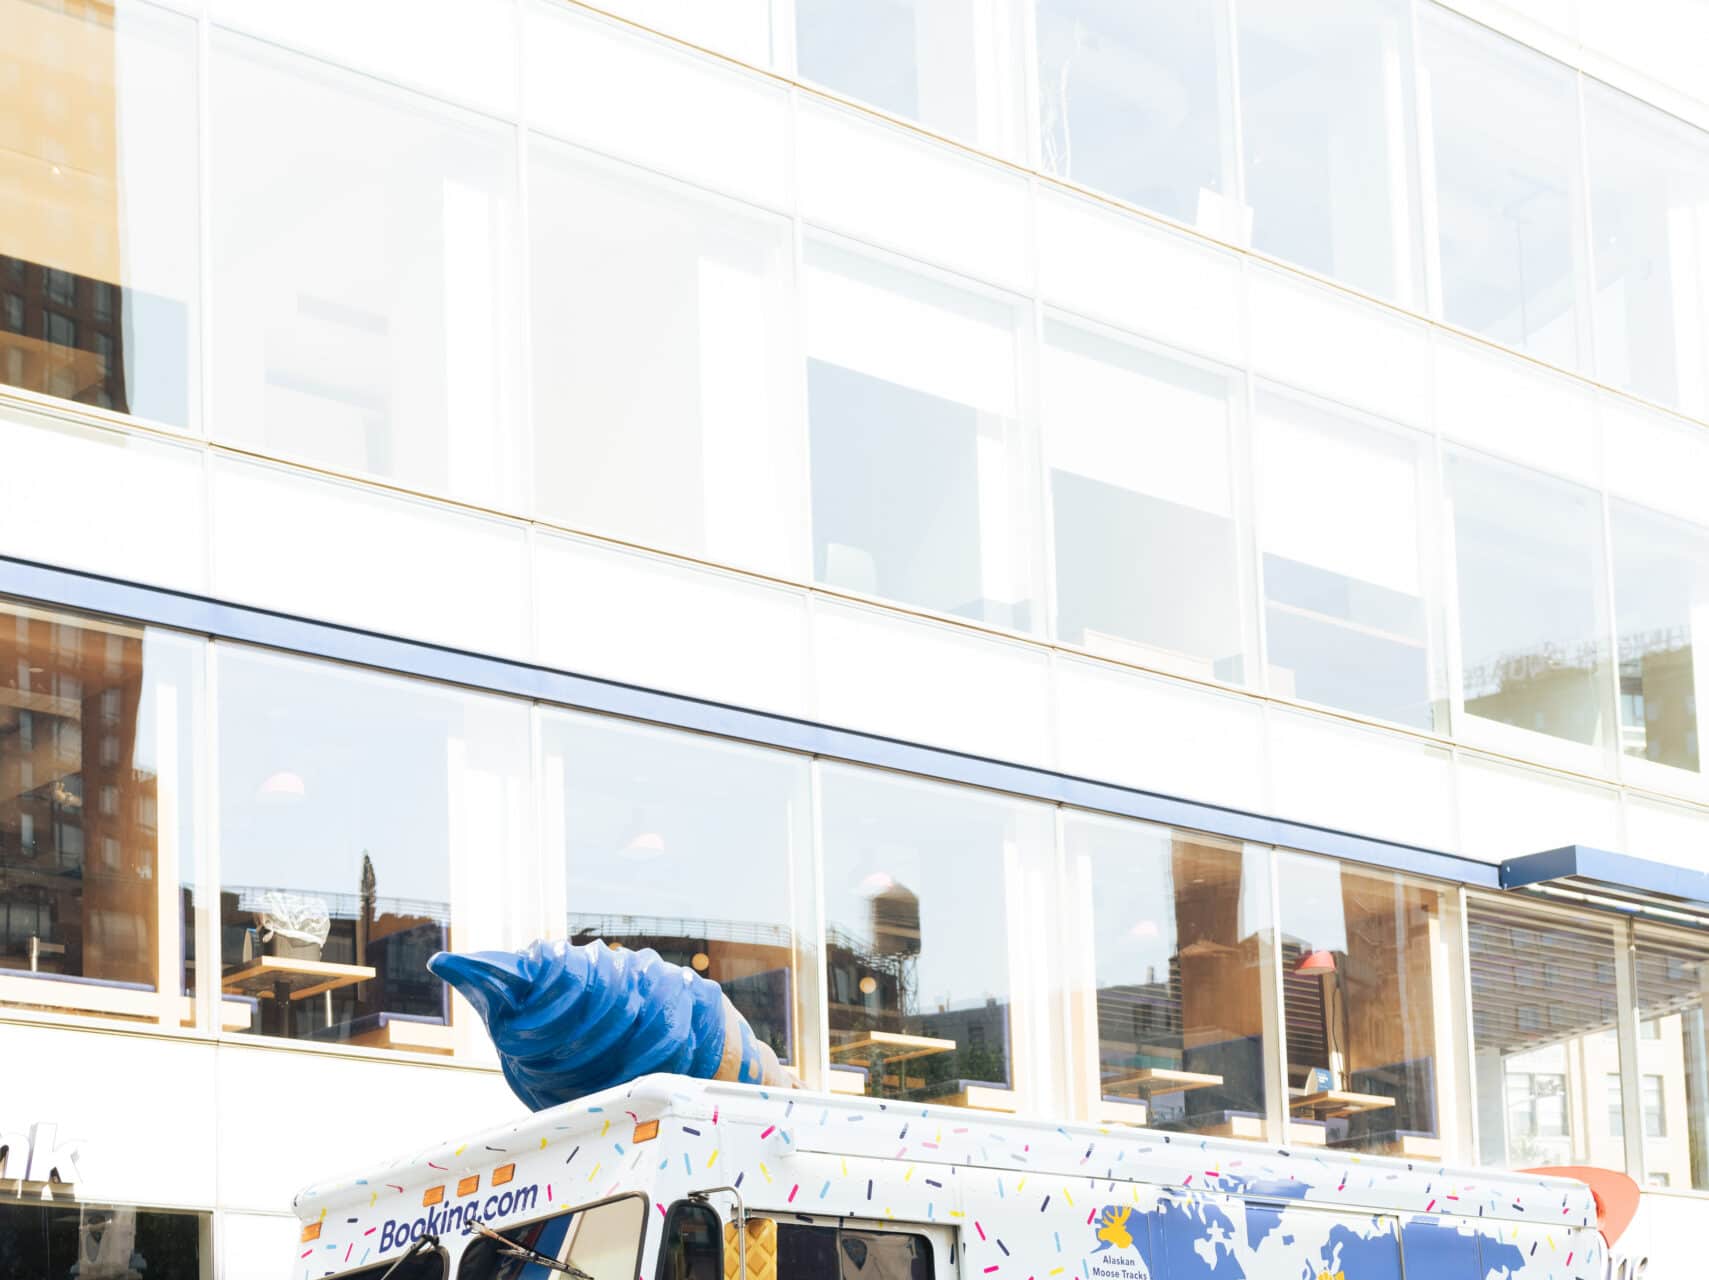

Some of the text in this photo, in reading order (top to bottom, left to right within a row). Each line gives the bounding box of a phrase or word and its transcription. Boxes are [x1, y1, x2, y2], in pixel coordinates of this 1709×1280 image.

[378, 1184, 539, 1254] Booking.com
[1102, 1255, 1135, 1266] Alaskan
[1092, 1267, 1148, 1280] Moose Tracks
